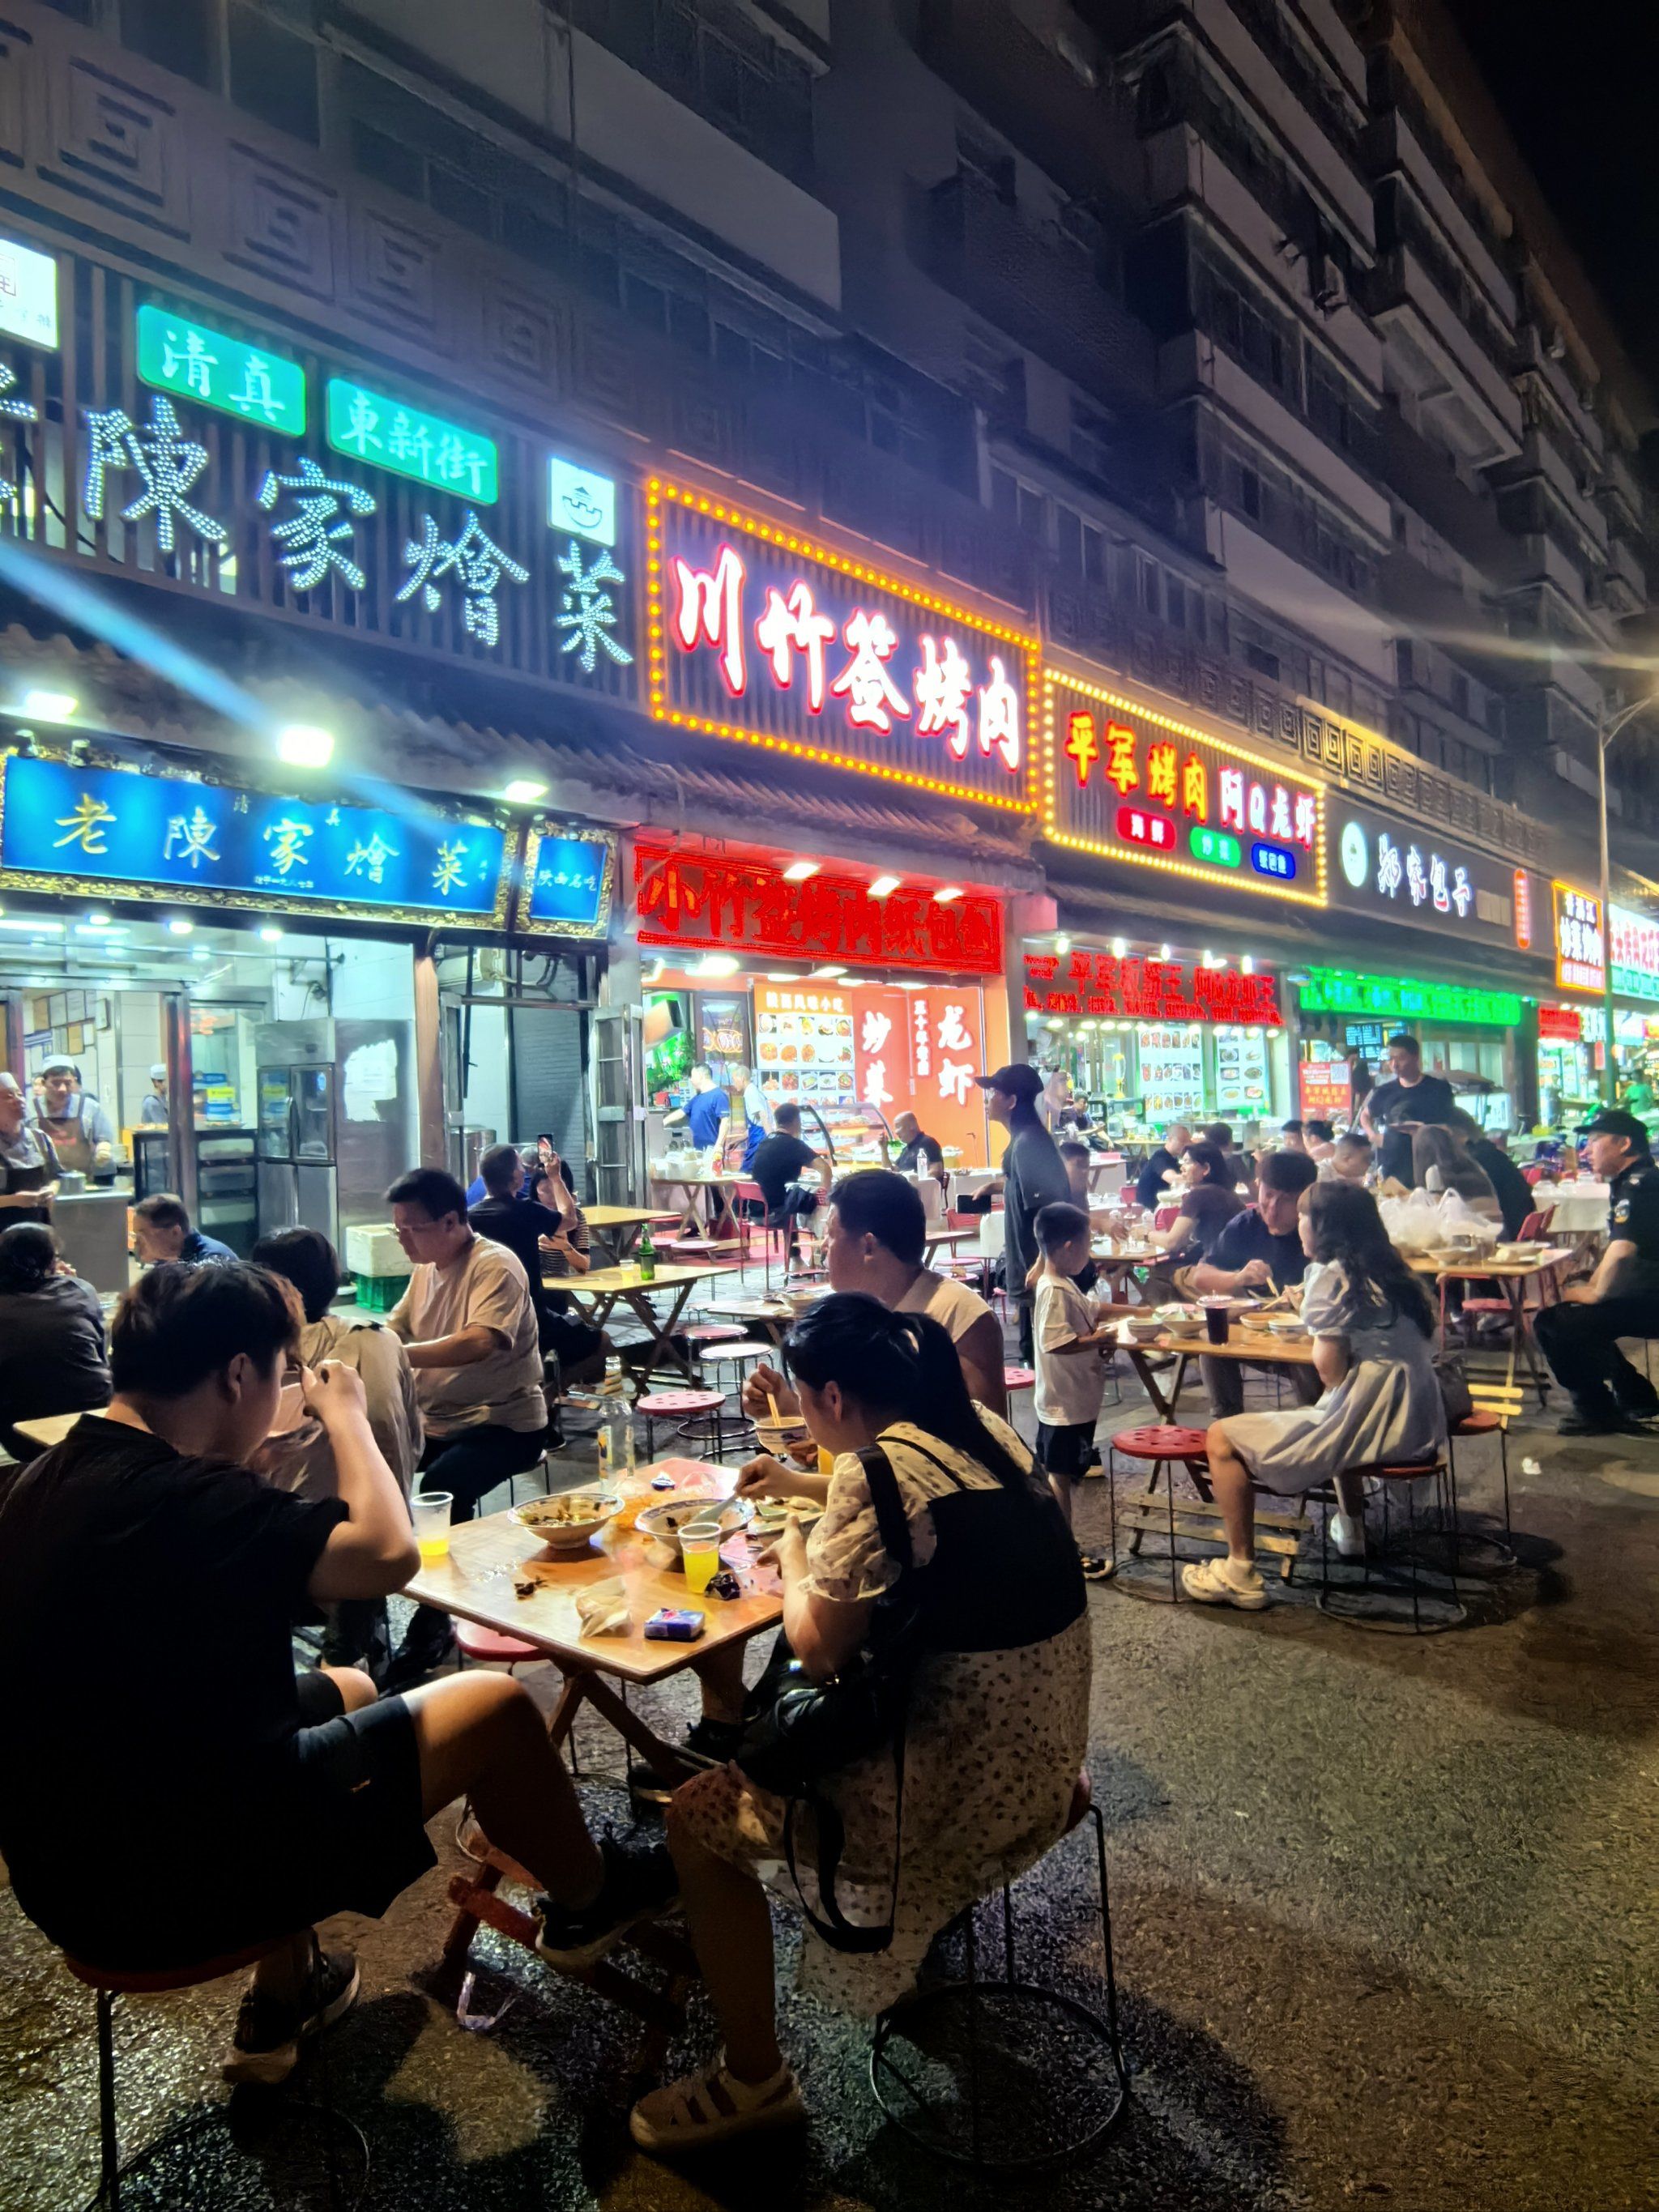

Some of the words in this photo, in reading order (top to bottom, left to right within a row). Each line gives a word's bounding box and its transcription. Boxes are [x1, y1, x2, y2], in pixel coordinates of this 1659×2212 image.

[161, 329, 286, 423] 清真
[339, 390, 488, 495] 東新街
[1064, 710, 1209, 825] 平军烤肉
[862, 1011, 893, 1108] 炒菜
[937, 1004, 975, 1106] 龙虾
